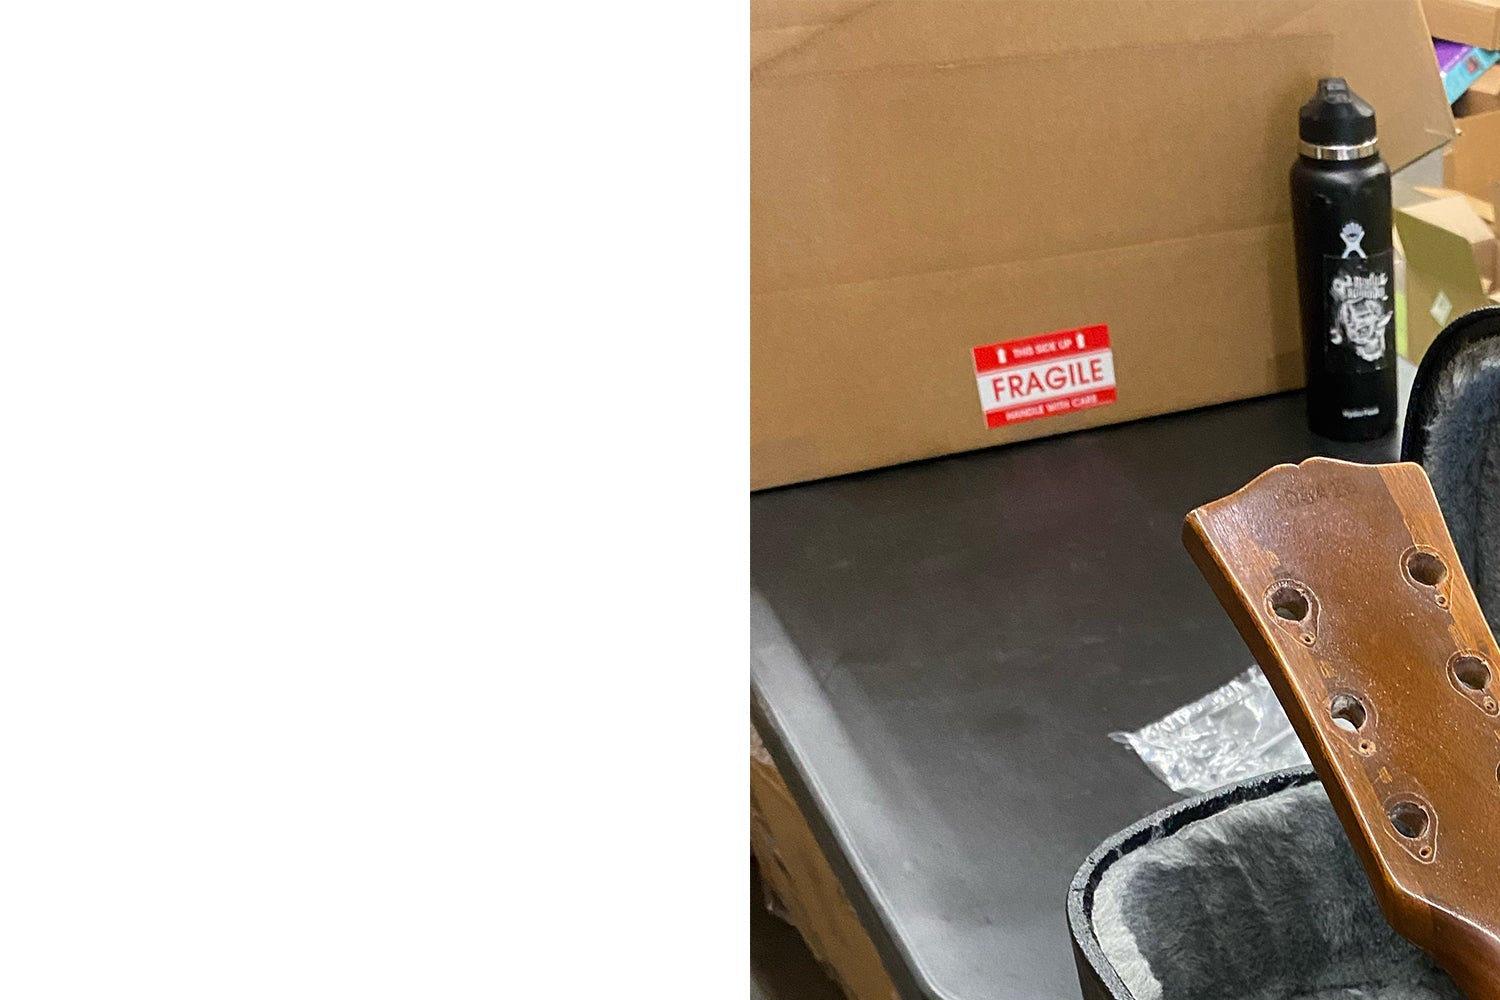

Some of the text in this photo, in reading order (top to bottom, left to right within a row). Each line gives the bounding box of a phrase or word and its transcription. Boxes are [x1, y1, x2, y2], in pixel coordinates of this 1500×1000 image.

[1012, 339, 1072, 358] THIS SIDE UP
[992, 359, 1104, 402] FRAGILE
[1006, 394, 1097, 421] HANDLE WITH CARE
